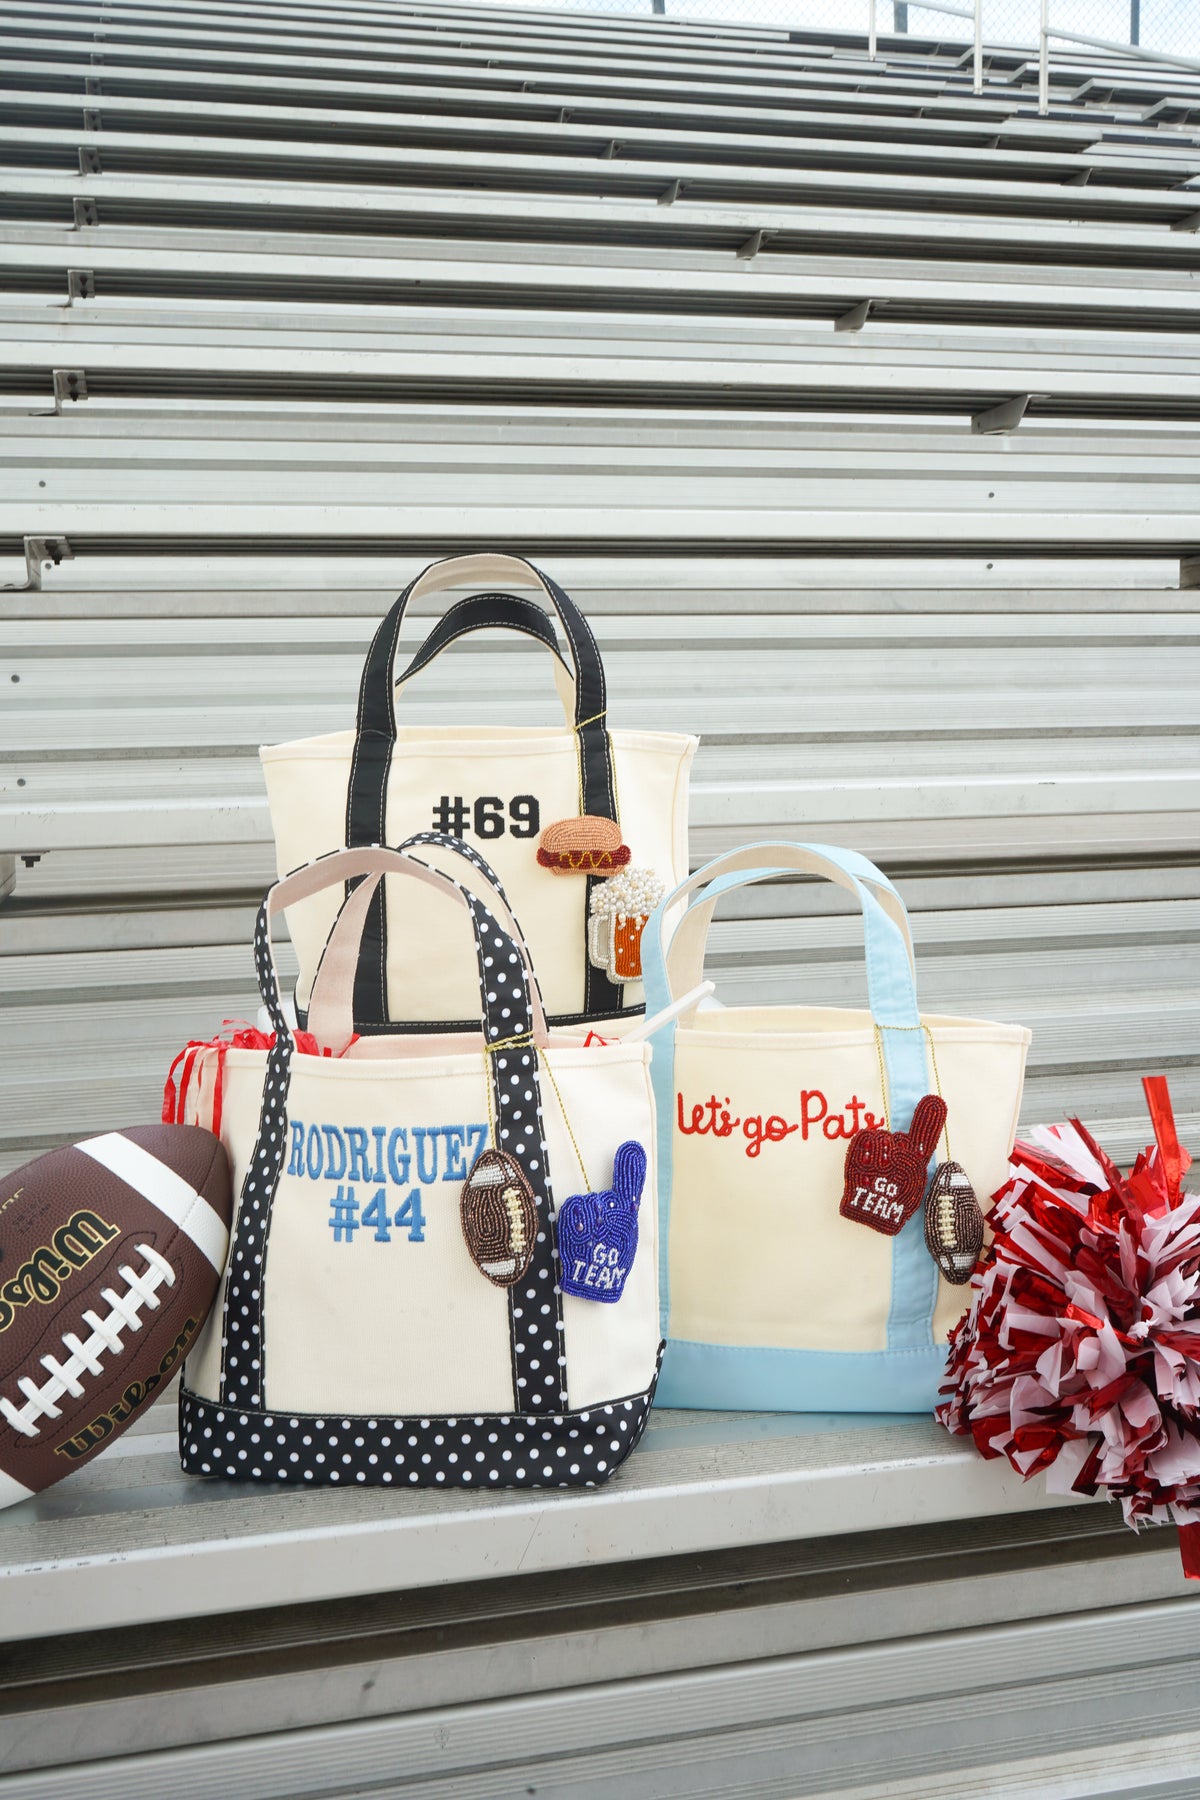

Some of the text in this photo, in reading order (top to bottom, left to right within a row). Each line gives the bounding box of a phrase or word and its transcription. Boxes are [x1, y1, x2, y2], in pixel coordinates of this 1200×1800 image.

[432, 795, 540, 839] #69
[287, 1120, 488, 1184] RODRIGUEZ
[743, 1115, 799, 1158] go
[850, 1187, 904, 1223] TEAM
[874, 1177, 897, 1196] GO
[328, 1185, 426, 1243] #44
[573, 1260, 626, 1291] TEAM
[592, 1243, 619, 1266] GO
[53, 1314, 202, 1461] Wilson
